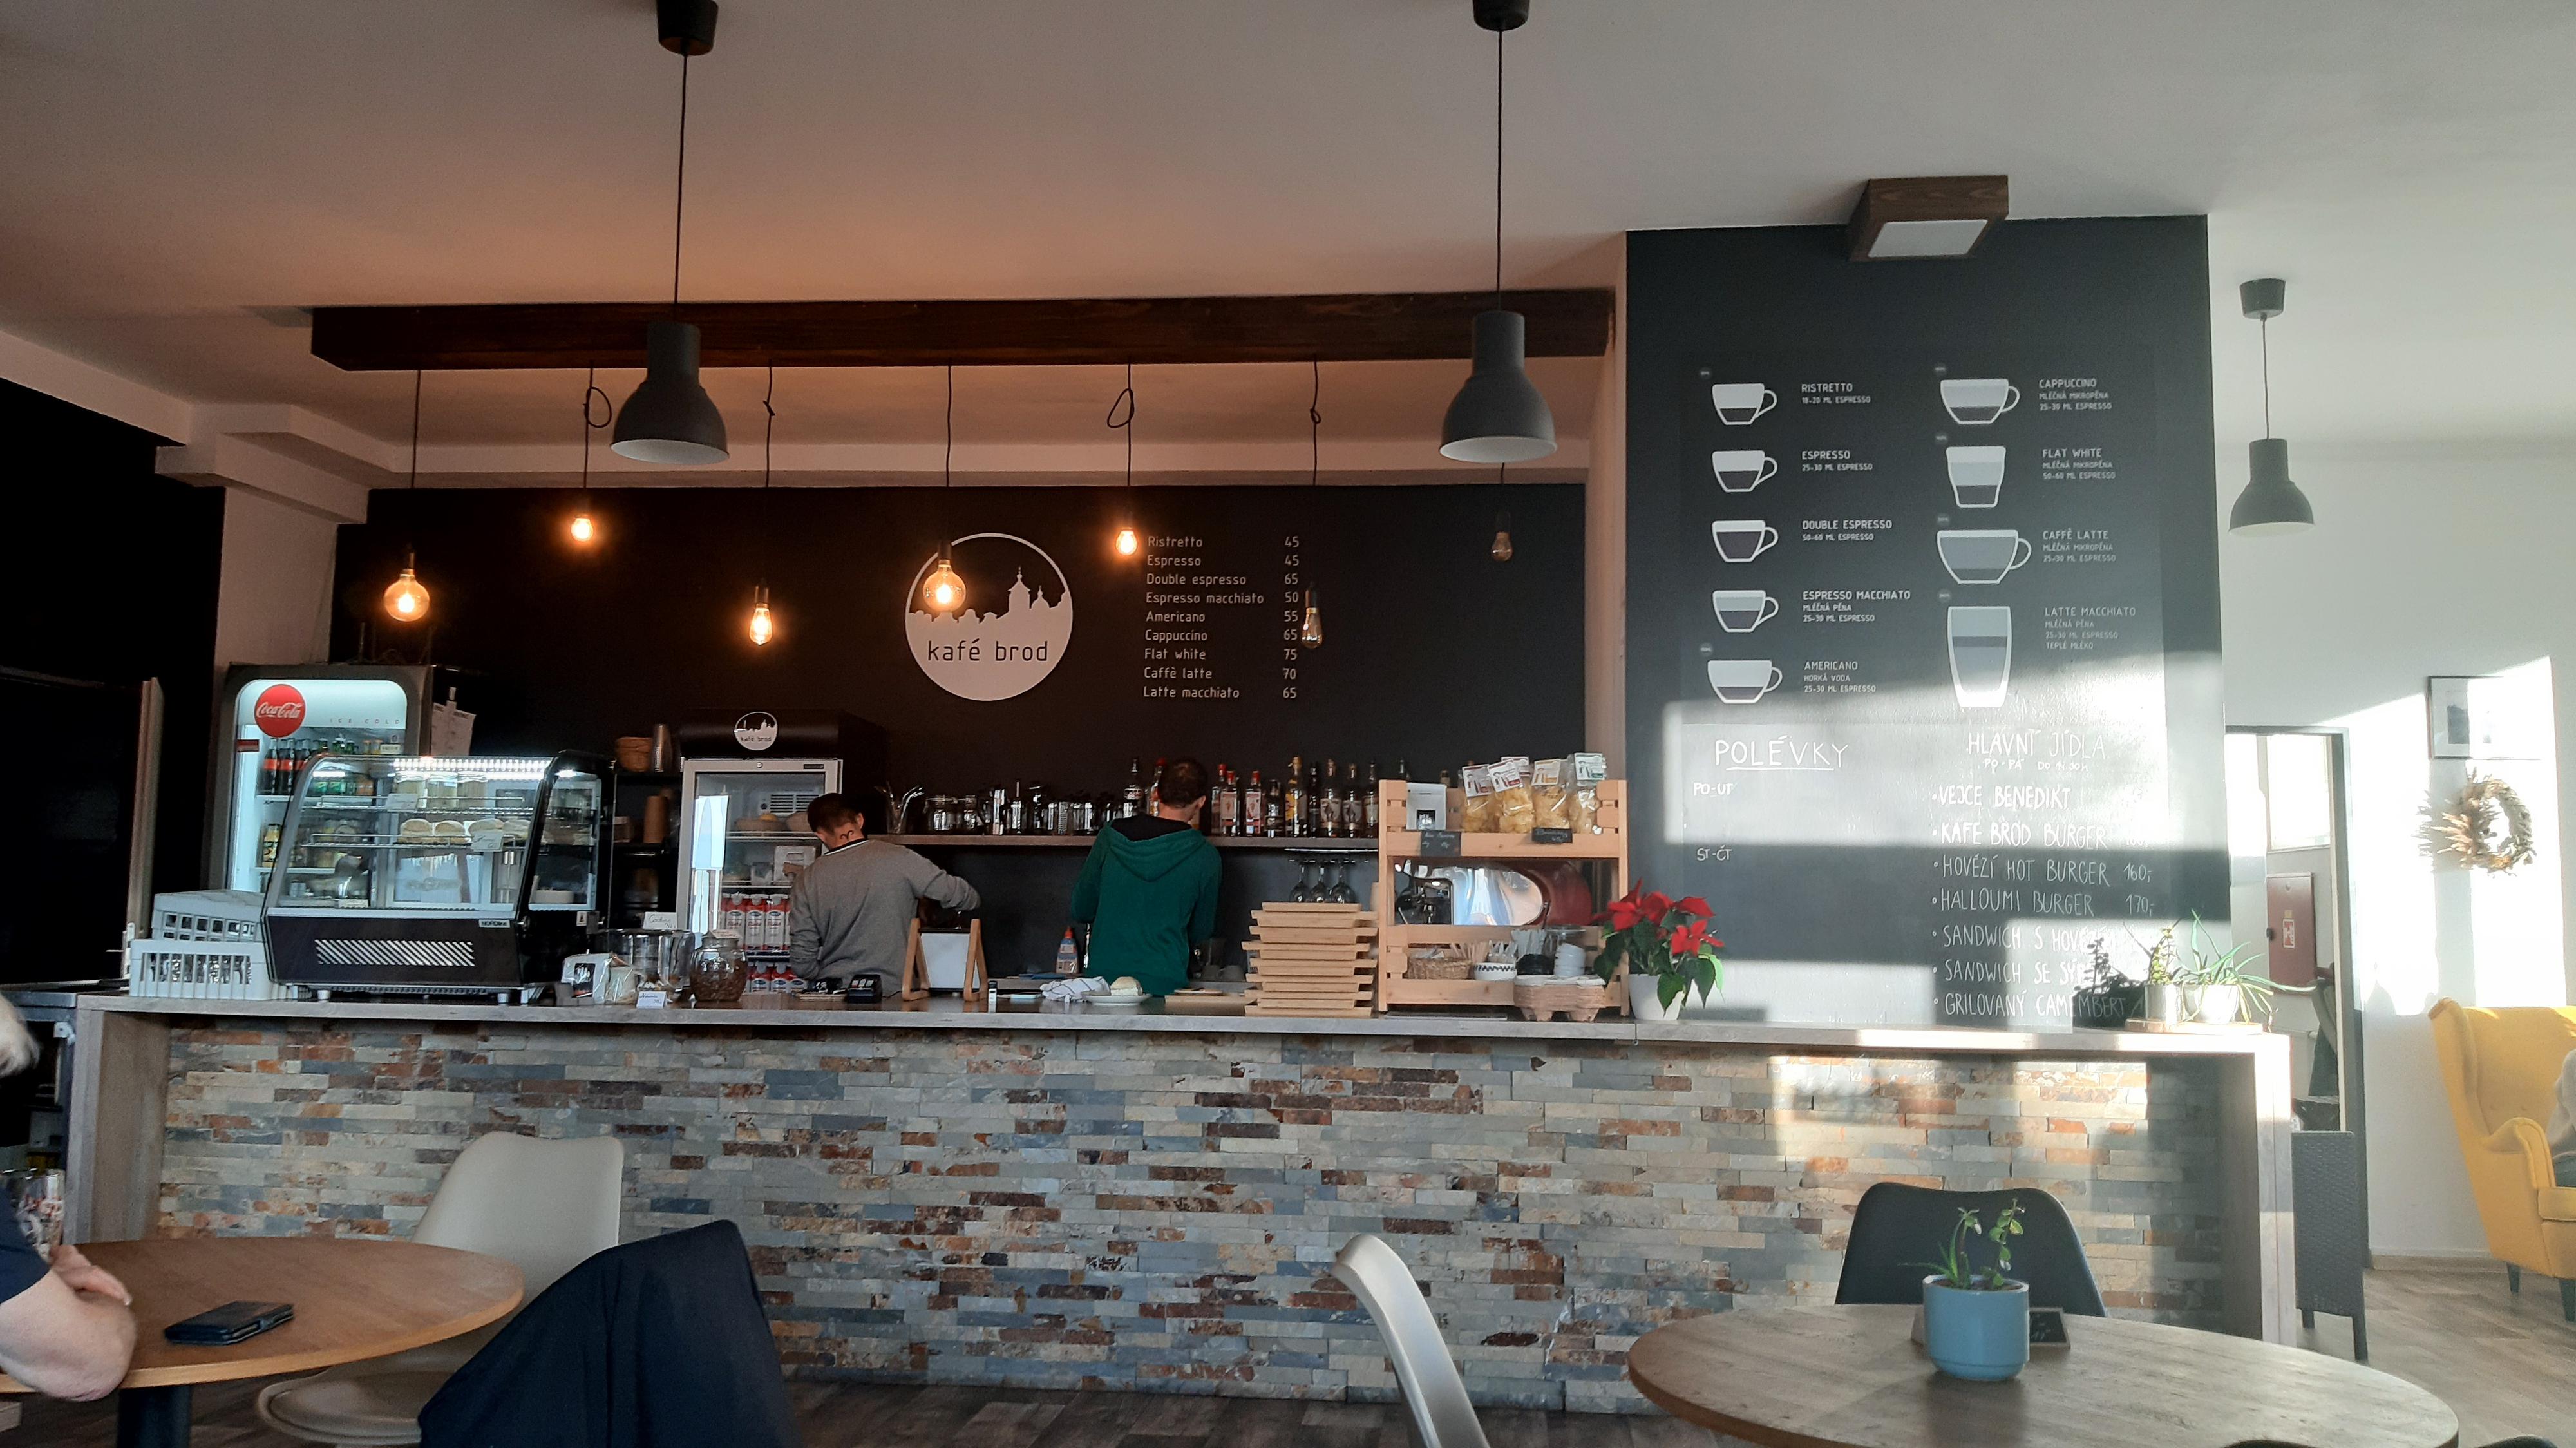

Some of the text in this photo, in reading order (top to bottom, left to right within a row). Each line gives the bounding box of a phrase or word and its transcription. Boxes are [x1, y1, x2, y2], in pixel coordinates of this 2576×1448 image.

[1801, 383, 1853, 393] RISTRETTO
[2039, 379, 2097, 388] CAPPUCCINO
[1802, 450, 1851, 460] ESPRESSO
[2043, 448, 2102, 458] FLAT WHITE
[1802, 519, 1893, 530] DOUBLE ESPRESSO
[1838, 533, 1874, 541] ESPRESSO
[2077, 530, 2109, 540] LATTE
[1148, 536, 1300, 548] Ristretto 45
[1147, 555, 1300, 568] Espresso 45
[1146, 573, 1298, 587] Double espresso 65
[1146, 591, 1299, 605] Espresso macchiato 50
[1803, 590, 1911, 600] ESPRESSO MACCHIATO
[1146, 611, 1298, 622] Americano 55
[2045, 607, 2136, 616] LATTE MACCHIATO
[1145, 629, 1298, 643] Cappuccino 65
[928, 638, 1048, 661] kafé brod
[1144, 648, 1298, 660] Flat white 75
[1804, 661, 1858, 671] AMERICANO
[1144, 667, 1296, 680] Caffè latte 70
[1143, 686, 1297, 698] Latte macchiato 65
[2049, 729, 2106, 759] JÍDLA
[1715, 734, 1849, 768] POLÉVKY
[1939, 785, 2071, 810] VEJCE BENEDIKT
[1991, 822, 2031, 846] BROD
[2043, 823, 2108, 850] BURGER
[2007, 859, 2035, 881] HOT
[2046, 859, 2111, 887] BURGER
[1941, 887, 2020, 912] HALLOUMI
[2033, 891, 2095, 917] BURGER
[1943, 925, 2022, 950] SANDWICH
[2034, 926, 2043, 950] S
[1945, 959, 2022, 984] SANDWICH
[2034, 961, 2051, 984] SE
[1945, 989, 2027, 1017] GRILOVANÝ
